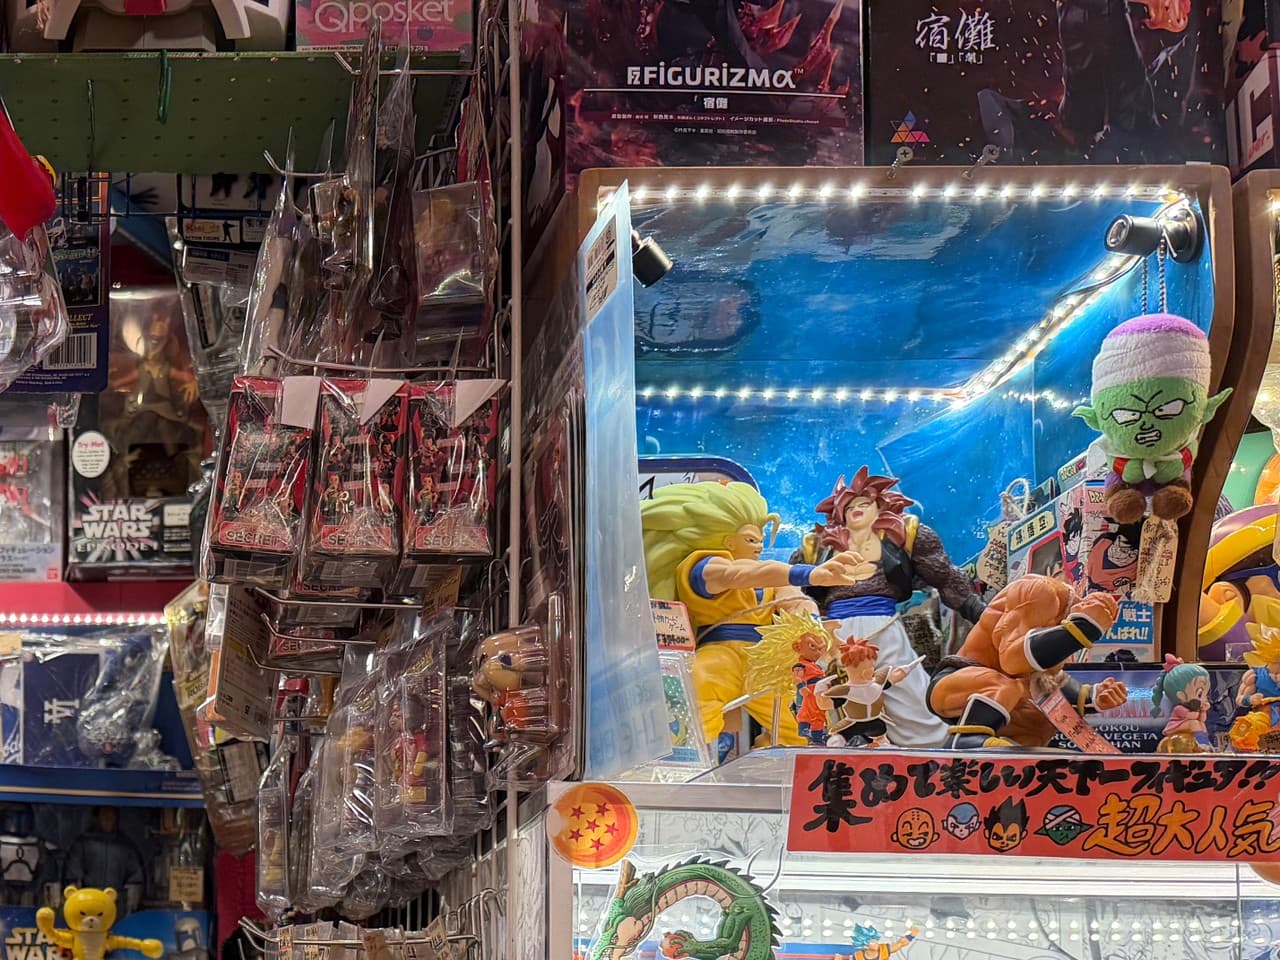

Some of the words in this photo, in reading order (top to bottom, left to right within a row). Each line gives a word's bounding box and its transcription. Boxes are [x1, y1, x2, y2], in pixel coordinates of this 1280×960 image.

[81, 504, 153, 521] STAR
[81, 520, 153, 539] WARS
[1081, 793, 1280, 857] 超大人気
[5, 927, 56, 945] STA
